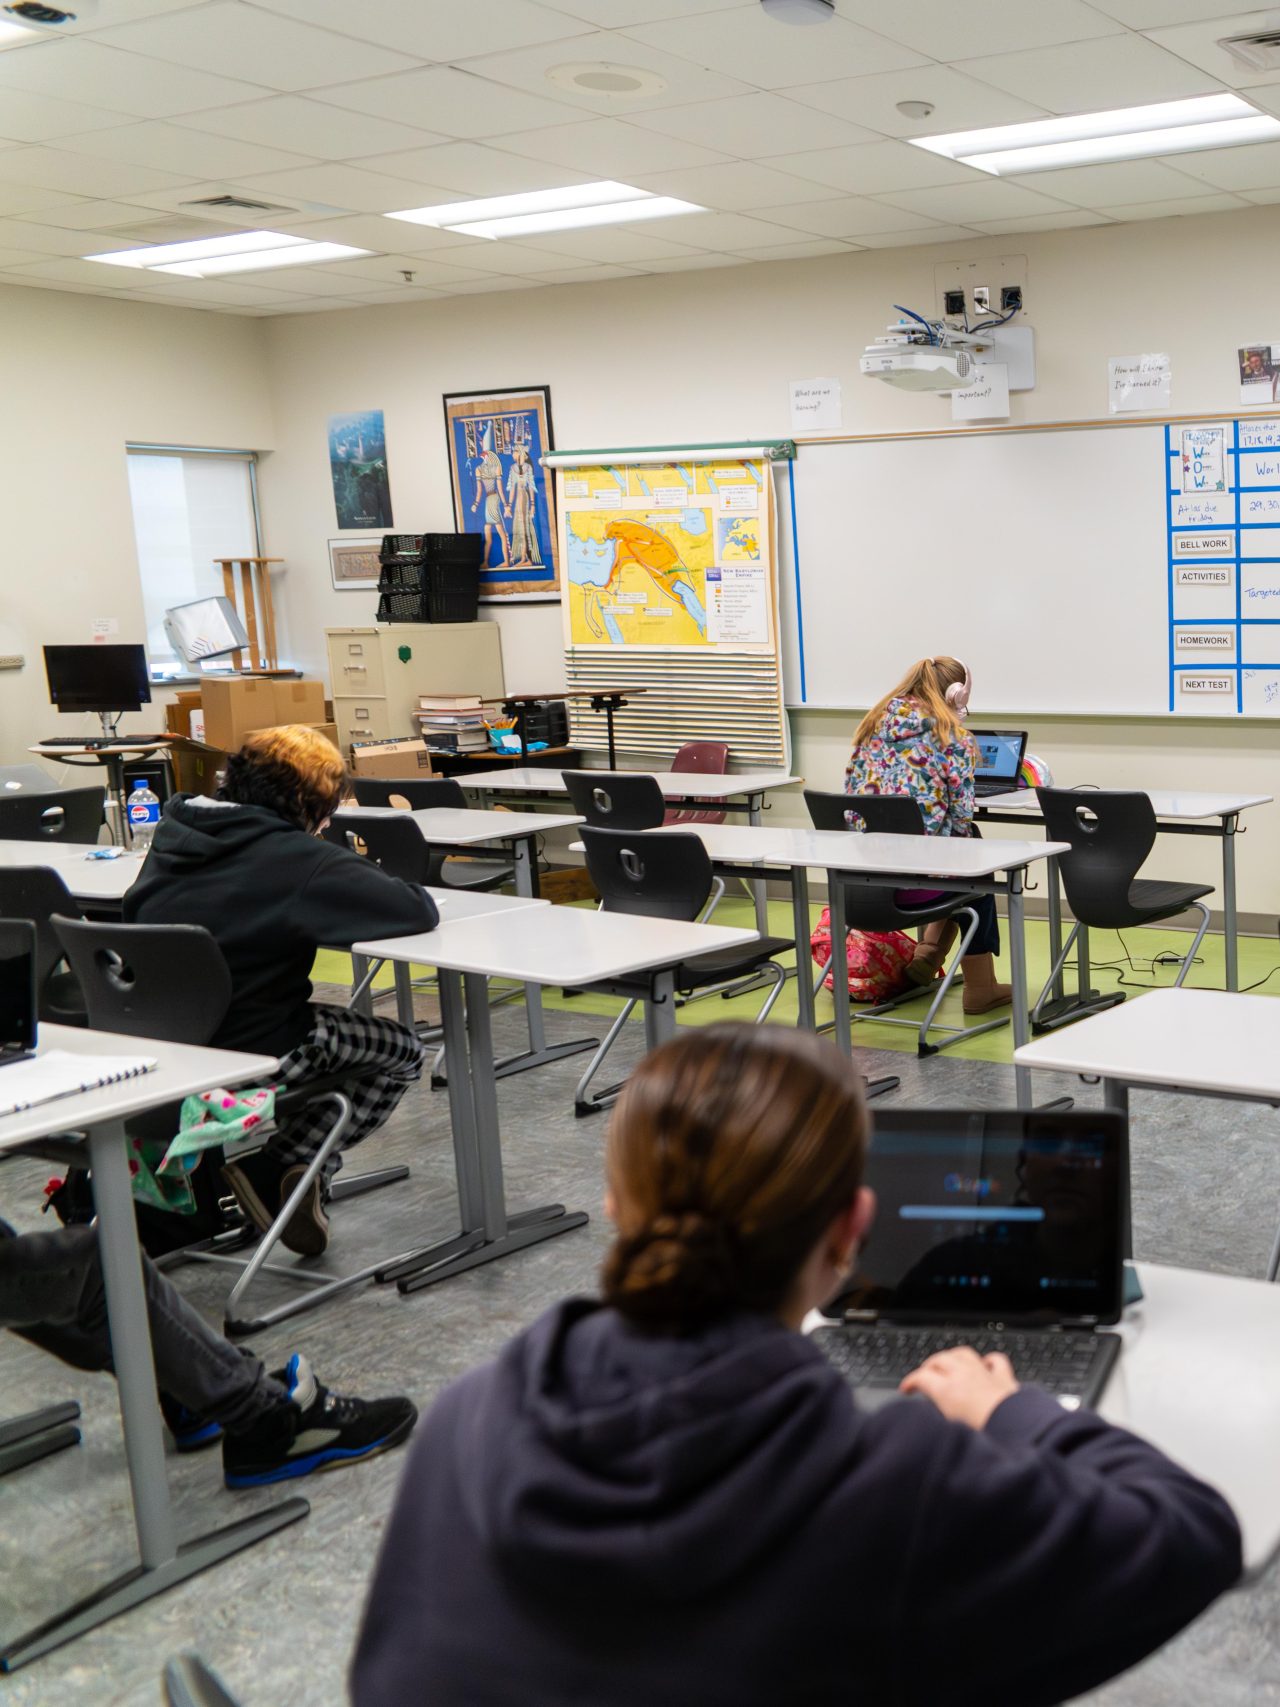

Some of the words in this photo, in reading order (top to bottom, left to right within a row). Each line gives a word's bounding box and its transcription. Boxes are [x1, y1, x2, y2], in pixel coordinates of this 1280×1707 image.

[1180, 541, 1200, 549] BELL
[1202, 539, 1227, 548] WORK
[1181, 573, 1226, 581] ACTIVITIES
[1244, 588, 1280, 599] Targeted
[1180, 637, 1228, 645] HOMEWORK
[1185, 681, 1207, 689] NEXT
[1209, 681, 1228, 689] TEST
